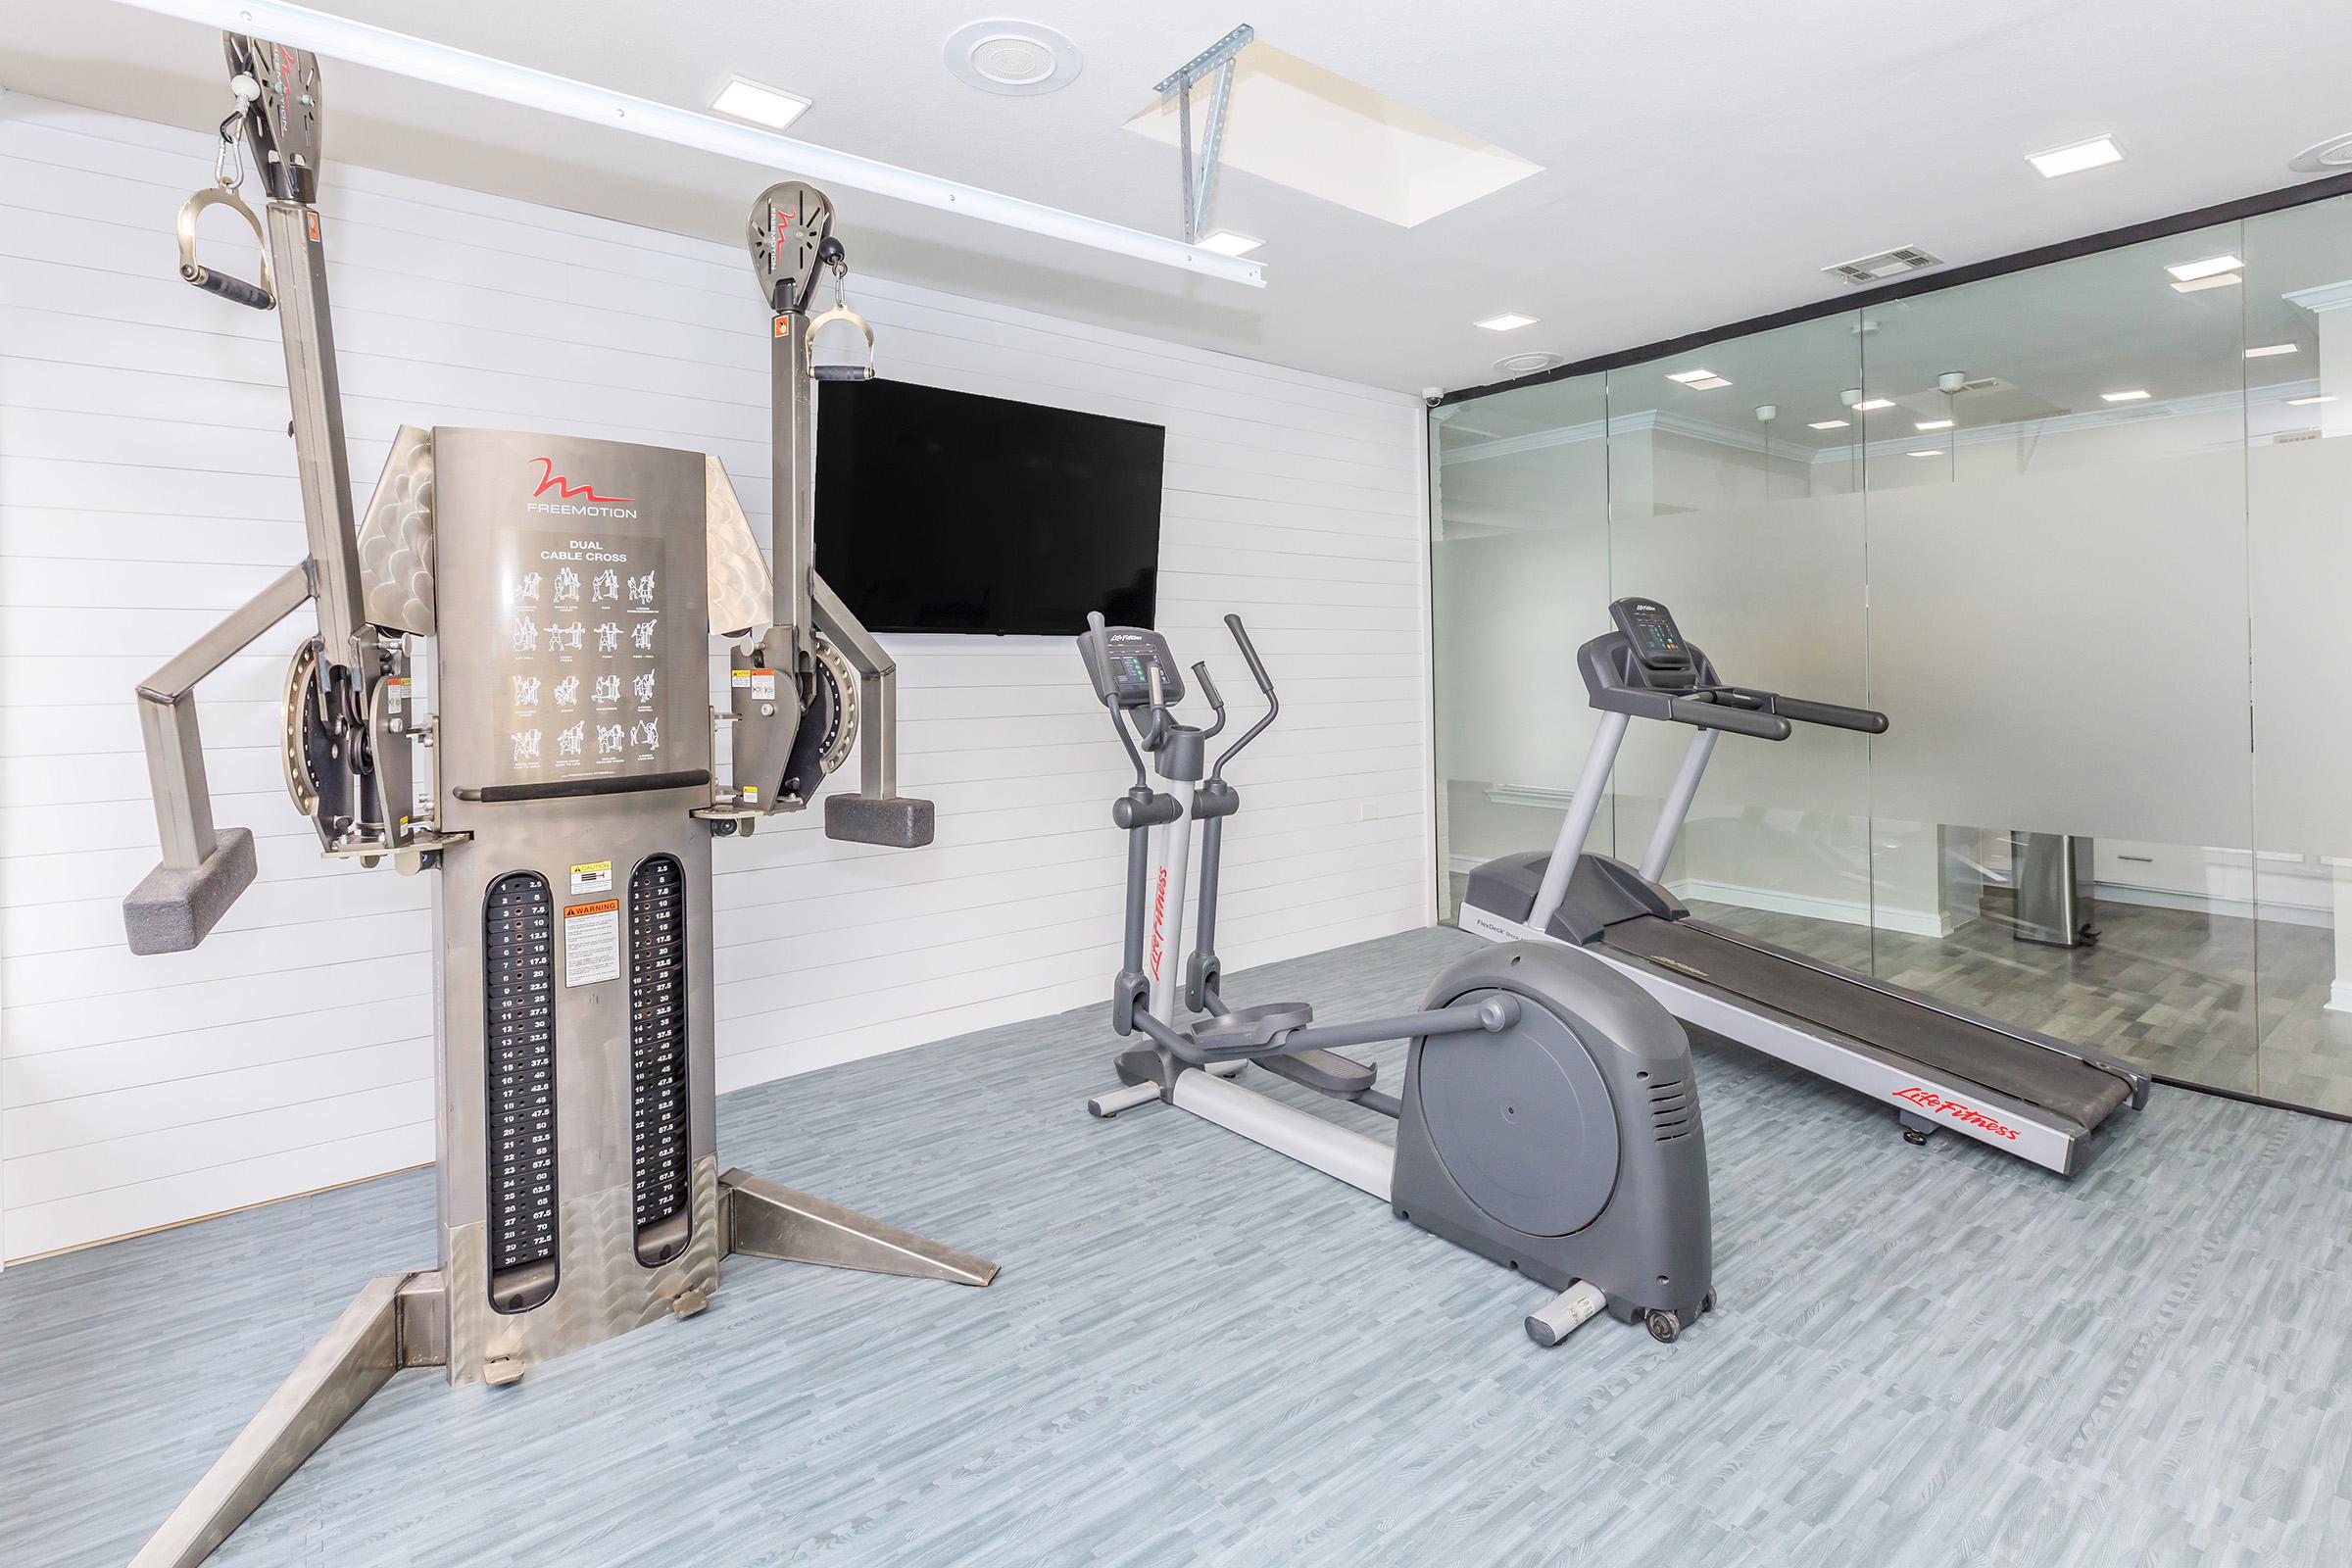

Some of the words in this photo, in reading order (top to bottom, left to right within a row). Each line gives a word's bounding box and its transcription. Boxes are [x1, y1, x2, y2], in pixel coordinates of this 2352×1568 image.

[527, 503, 637, 518] FREEMOTION
[569, 540, 603, 550] DUAL
[540, 551, 583, 561] CABLE
[585, 553, 627, 562] CROSS
[581, 862, 610, 871] CAUTION
[576, 902, 615, 914] WARNING
[1477, 919, 1505, 933] FlexDeck
[656, 935, 671, 943] 17.5
[656, 959, 671, 967] 22.5
[530, 982, 548, 990] 22.5
[656, 982, 671, 991] 27.5
[530, 1008, 547, 1016] 27.5
[656, 1006, 671, 1015] 32.5
[530, 1033, 547, 1041] 32.5
[657, 1029, 672, 1038] 37.5
[657, 1053, 672, 1062] 42.5
[531, 1058, 549, 1067] 37.5
[658, 1077, 673, 1086] 47.5
[531, 1083, 549, 1092] 42.5
[658, 1100, 673, 1110] 52.5
[532, 1109, 549, 1117] 47.5
[503, 1128, 514, 1136] 20
[659, 1124, 673, 1133] 57.5
[533, 1134, 550, 1143] 52.5
[636, 1145, 645, 1153] 24
[659, 1147, 674, 1157] 62.5
[533, 1159, 550, 1169] 57.5
[503, 1180, 515, 1188] 24
[637, 1181, 645, 1189] 27
[659, 1171, 674, 1181] 67.5
[504, 1192, 515, 1201] 25
[533, 1184, 551, 1194] 62.5
[659, 1194, 674, 1205] 72.5
[505, 1205, 516, 1213] 26
[663, 1207, 672, 1215] 75
[505, 1218, 516, 1226] 27
[533, 1209, 551, 1219] 67.5
[534, 1235, 552, 1245] 72.5
[537, 1248, 548, 1256] 75
